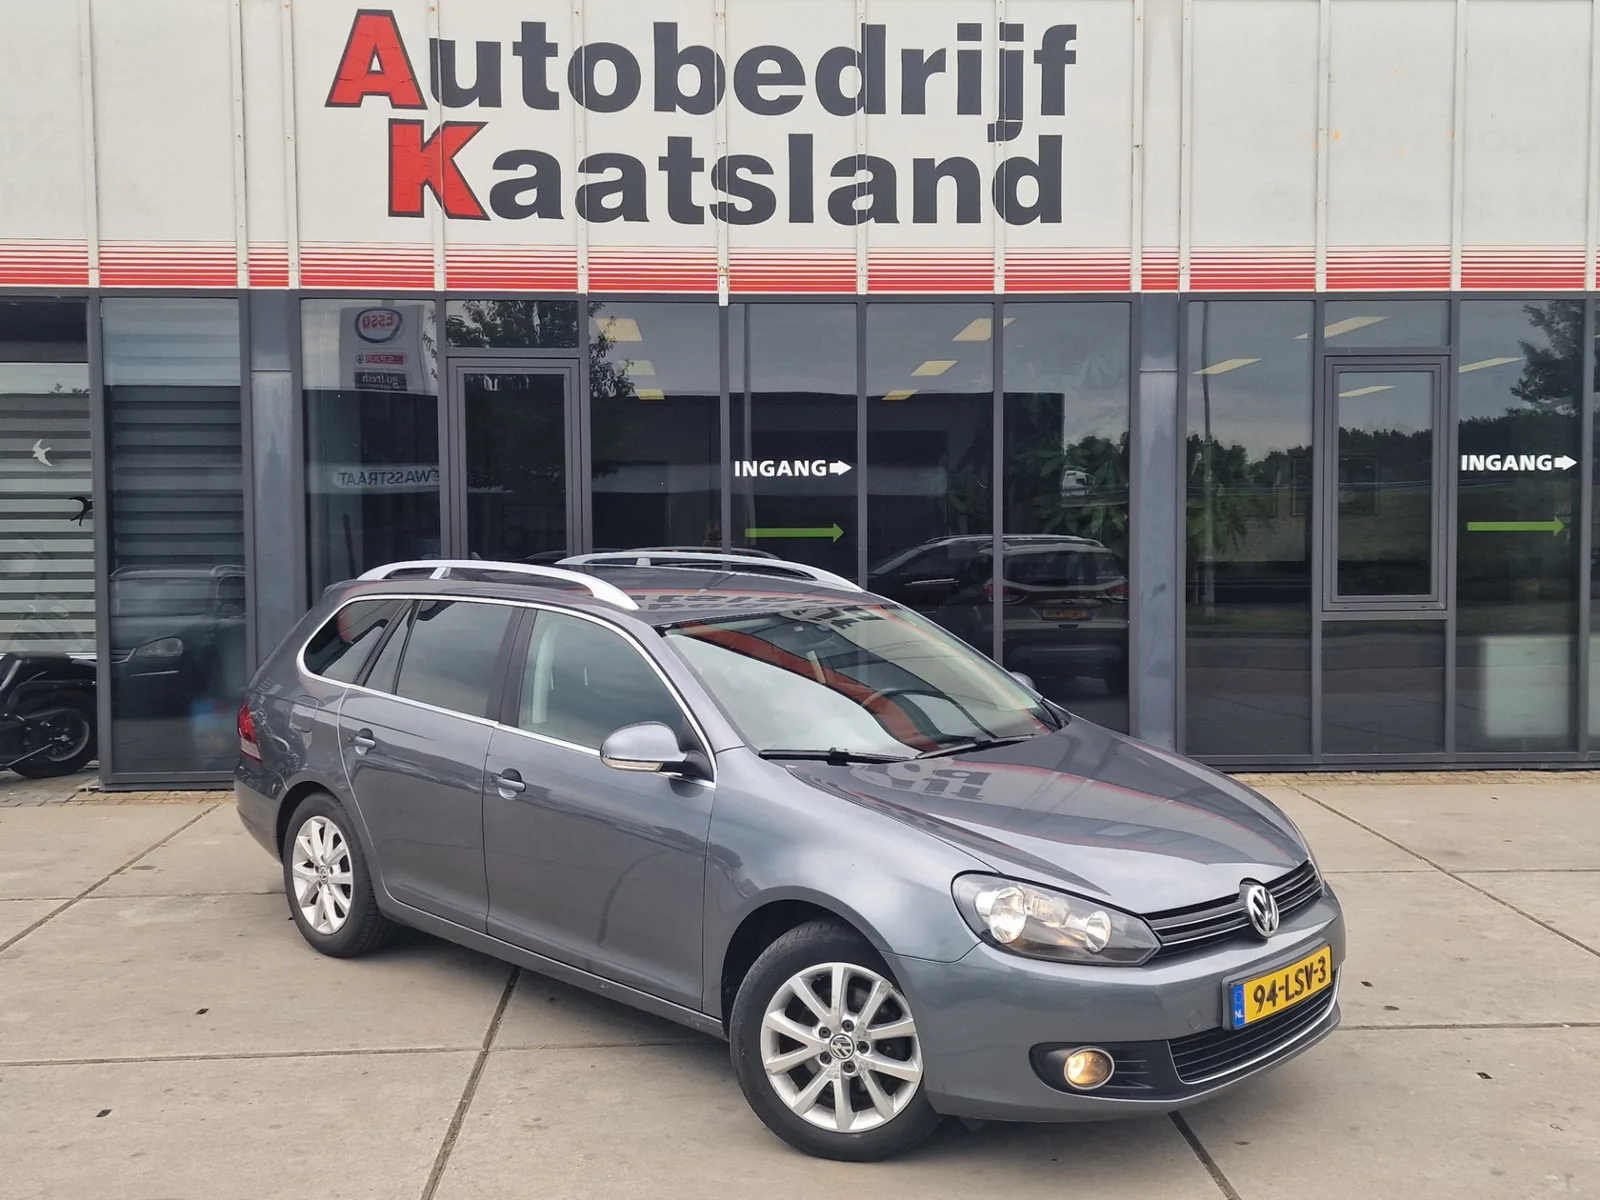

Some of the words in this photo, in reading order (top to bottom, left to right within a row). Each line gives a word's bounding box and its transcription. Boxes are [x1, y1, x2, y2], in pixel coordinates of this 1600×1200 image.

[325, 9, 1077, 142] Autobedrijf
[387, 118, 1063, 224] Kaatsland
[734, 460, 827, 477] INGANG
[1461, 455, 1552, 471] INGANG
[1253, 956, 1327, 1014] 94-LSV-3
[1234, 1009, 1243, 1019] NL
